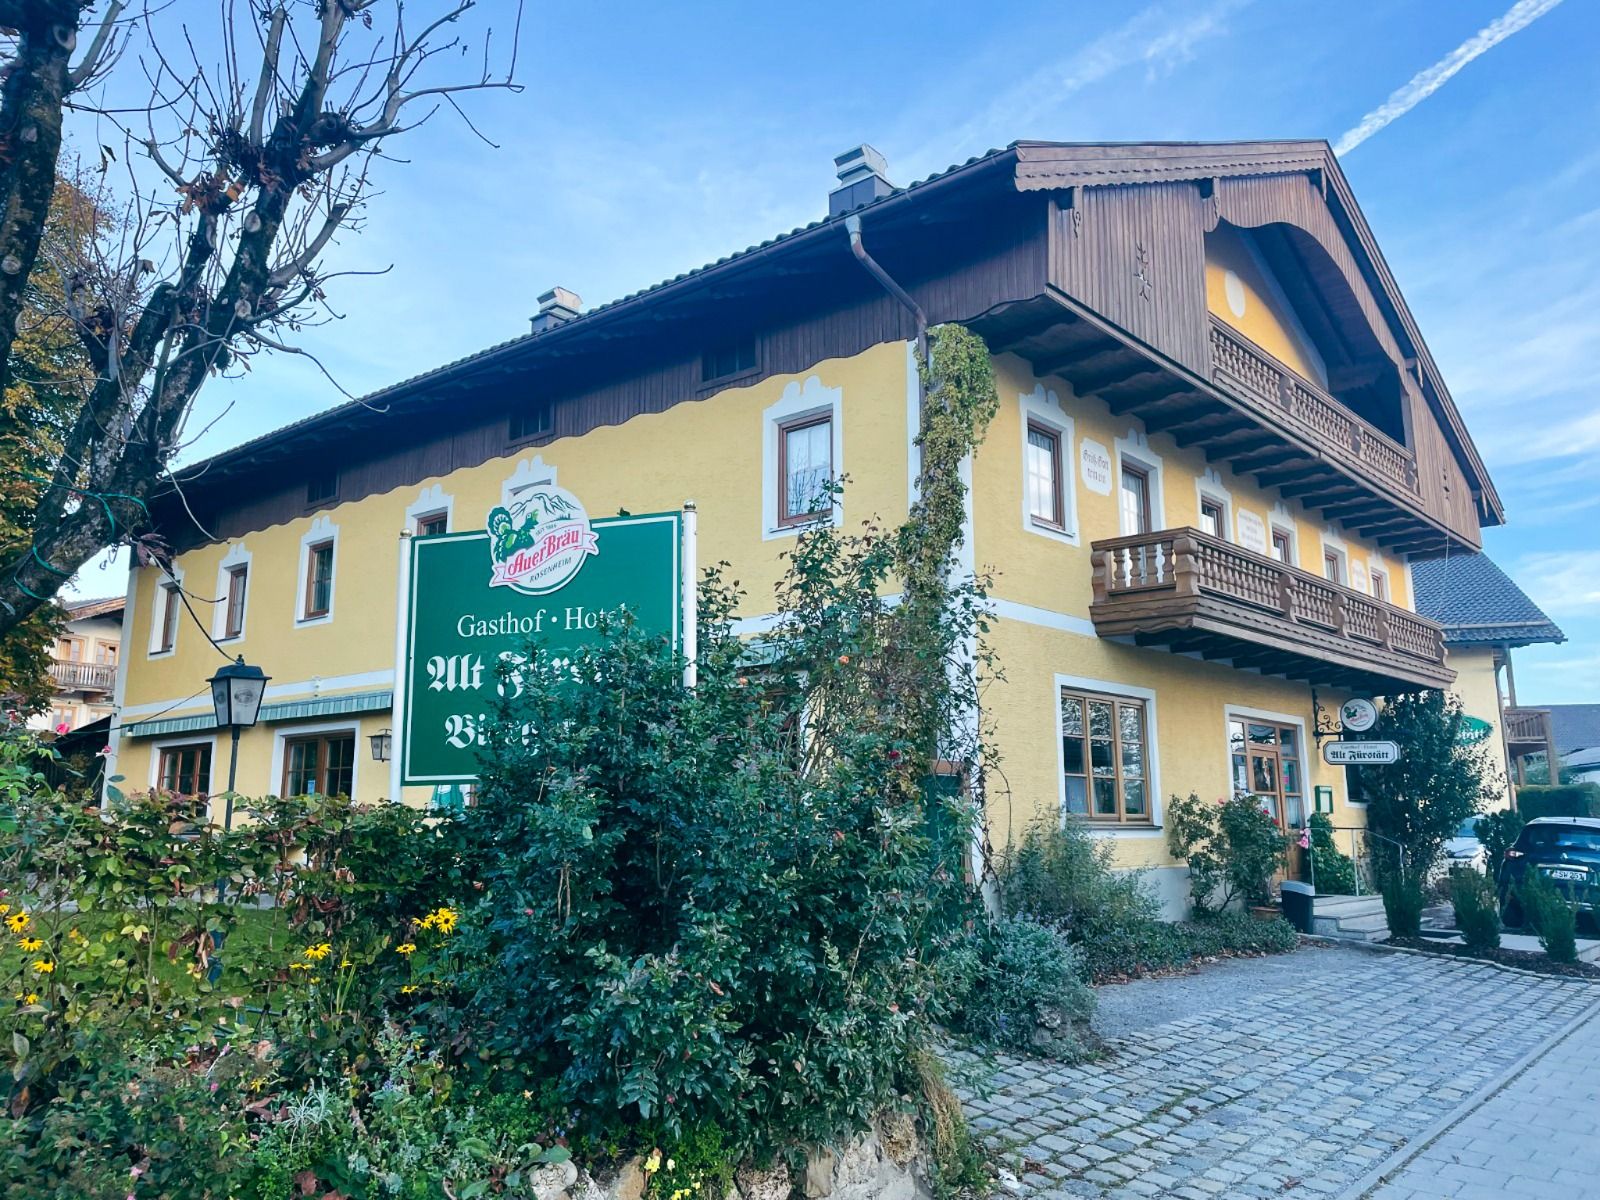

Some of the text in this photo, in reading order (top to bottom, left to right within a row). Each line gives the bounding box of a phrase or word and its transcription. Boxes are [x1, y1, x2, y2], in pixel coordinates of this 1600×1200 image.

[508, 529, 579, 576] AuerBräu
[529, 556, 572, 583] ROSENHEIM
[457, 609, 547, 638] Gasthof
[426, 653, 485, 692] Alt
[1330, 751, 1346, 759] Alt
